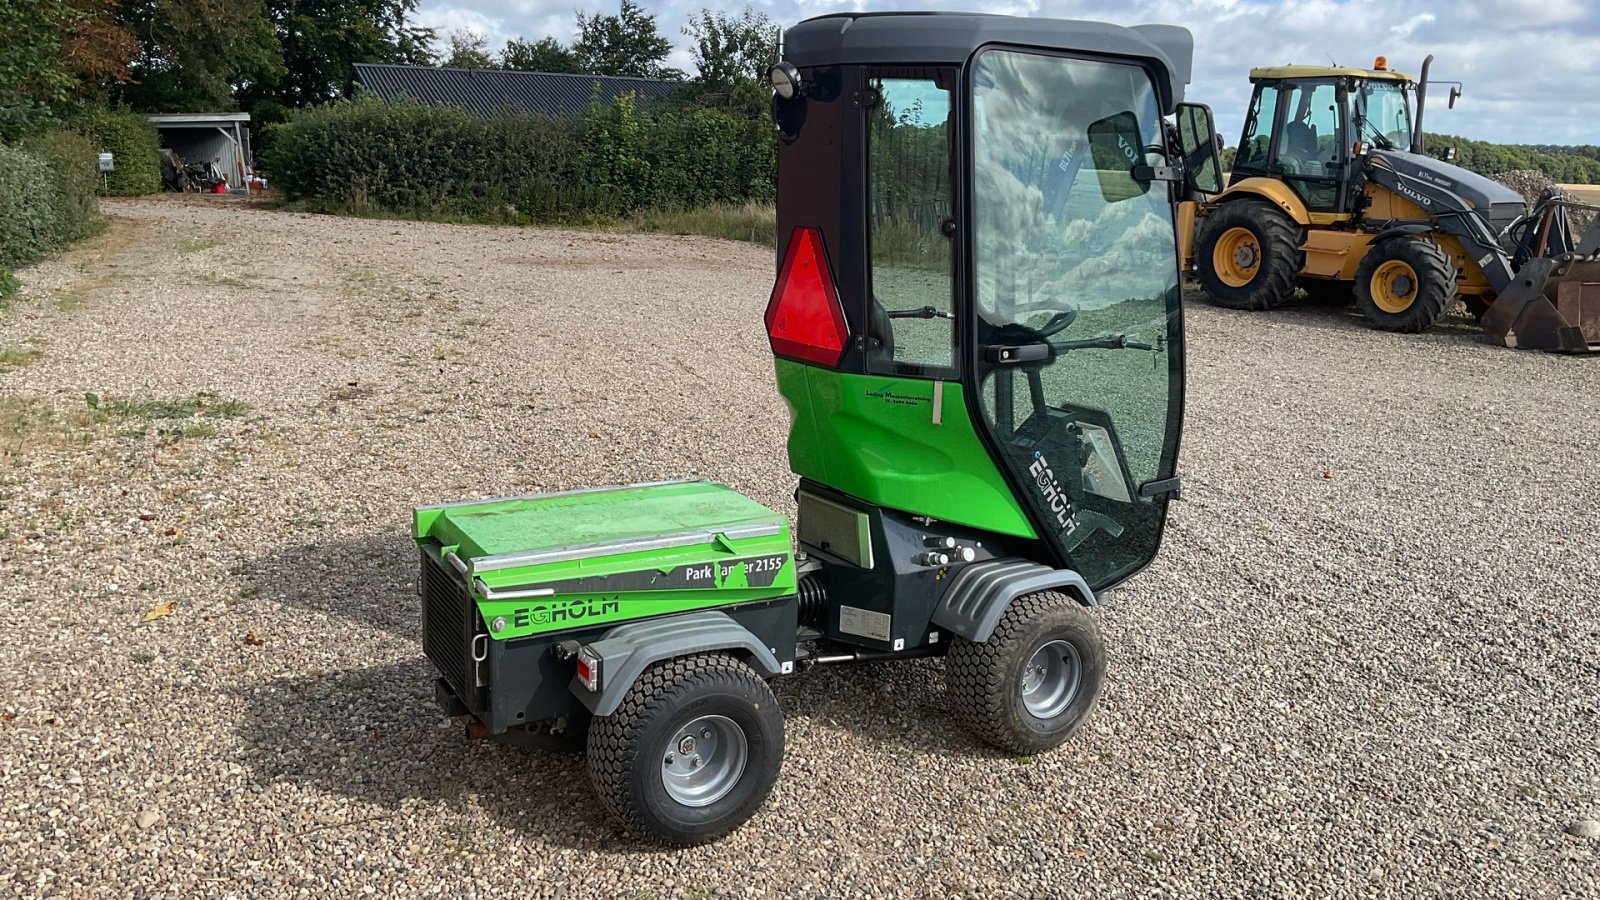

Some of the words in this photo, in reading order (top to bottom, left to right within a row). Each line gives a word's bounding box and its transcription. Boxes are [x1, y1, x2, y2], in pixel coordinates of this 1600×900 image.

[1396, 182, 1431, 206] VOLVO
[1028, 455, 1081, 537] EGHOLM
[685, 565, 712, 581] Park
[755, 557, 782, 572] 2155
[514, 595, 619, 628] EGHOLM
